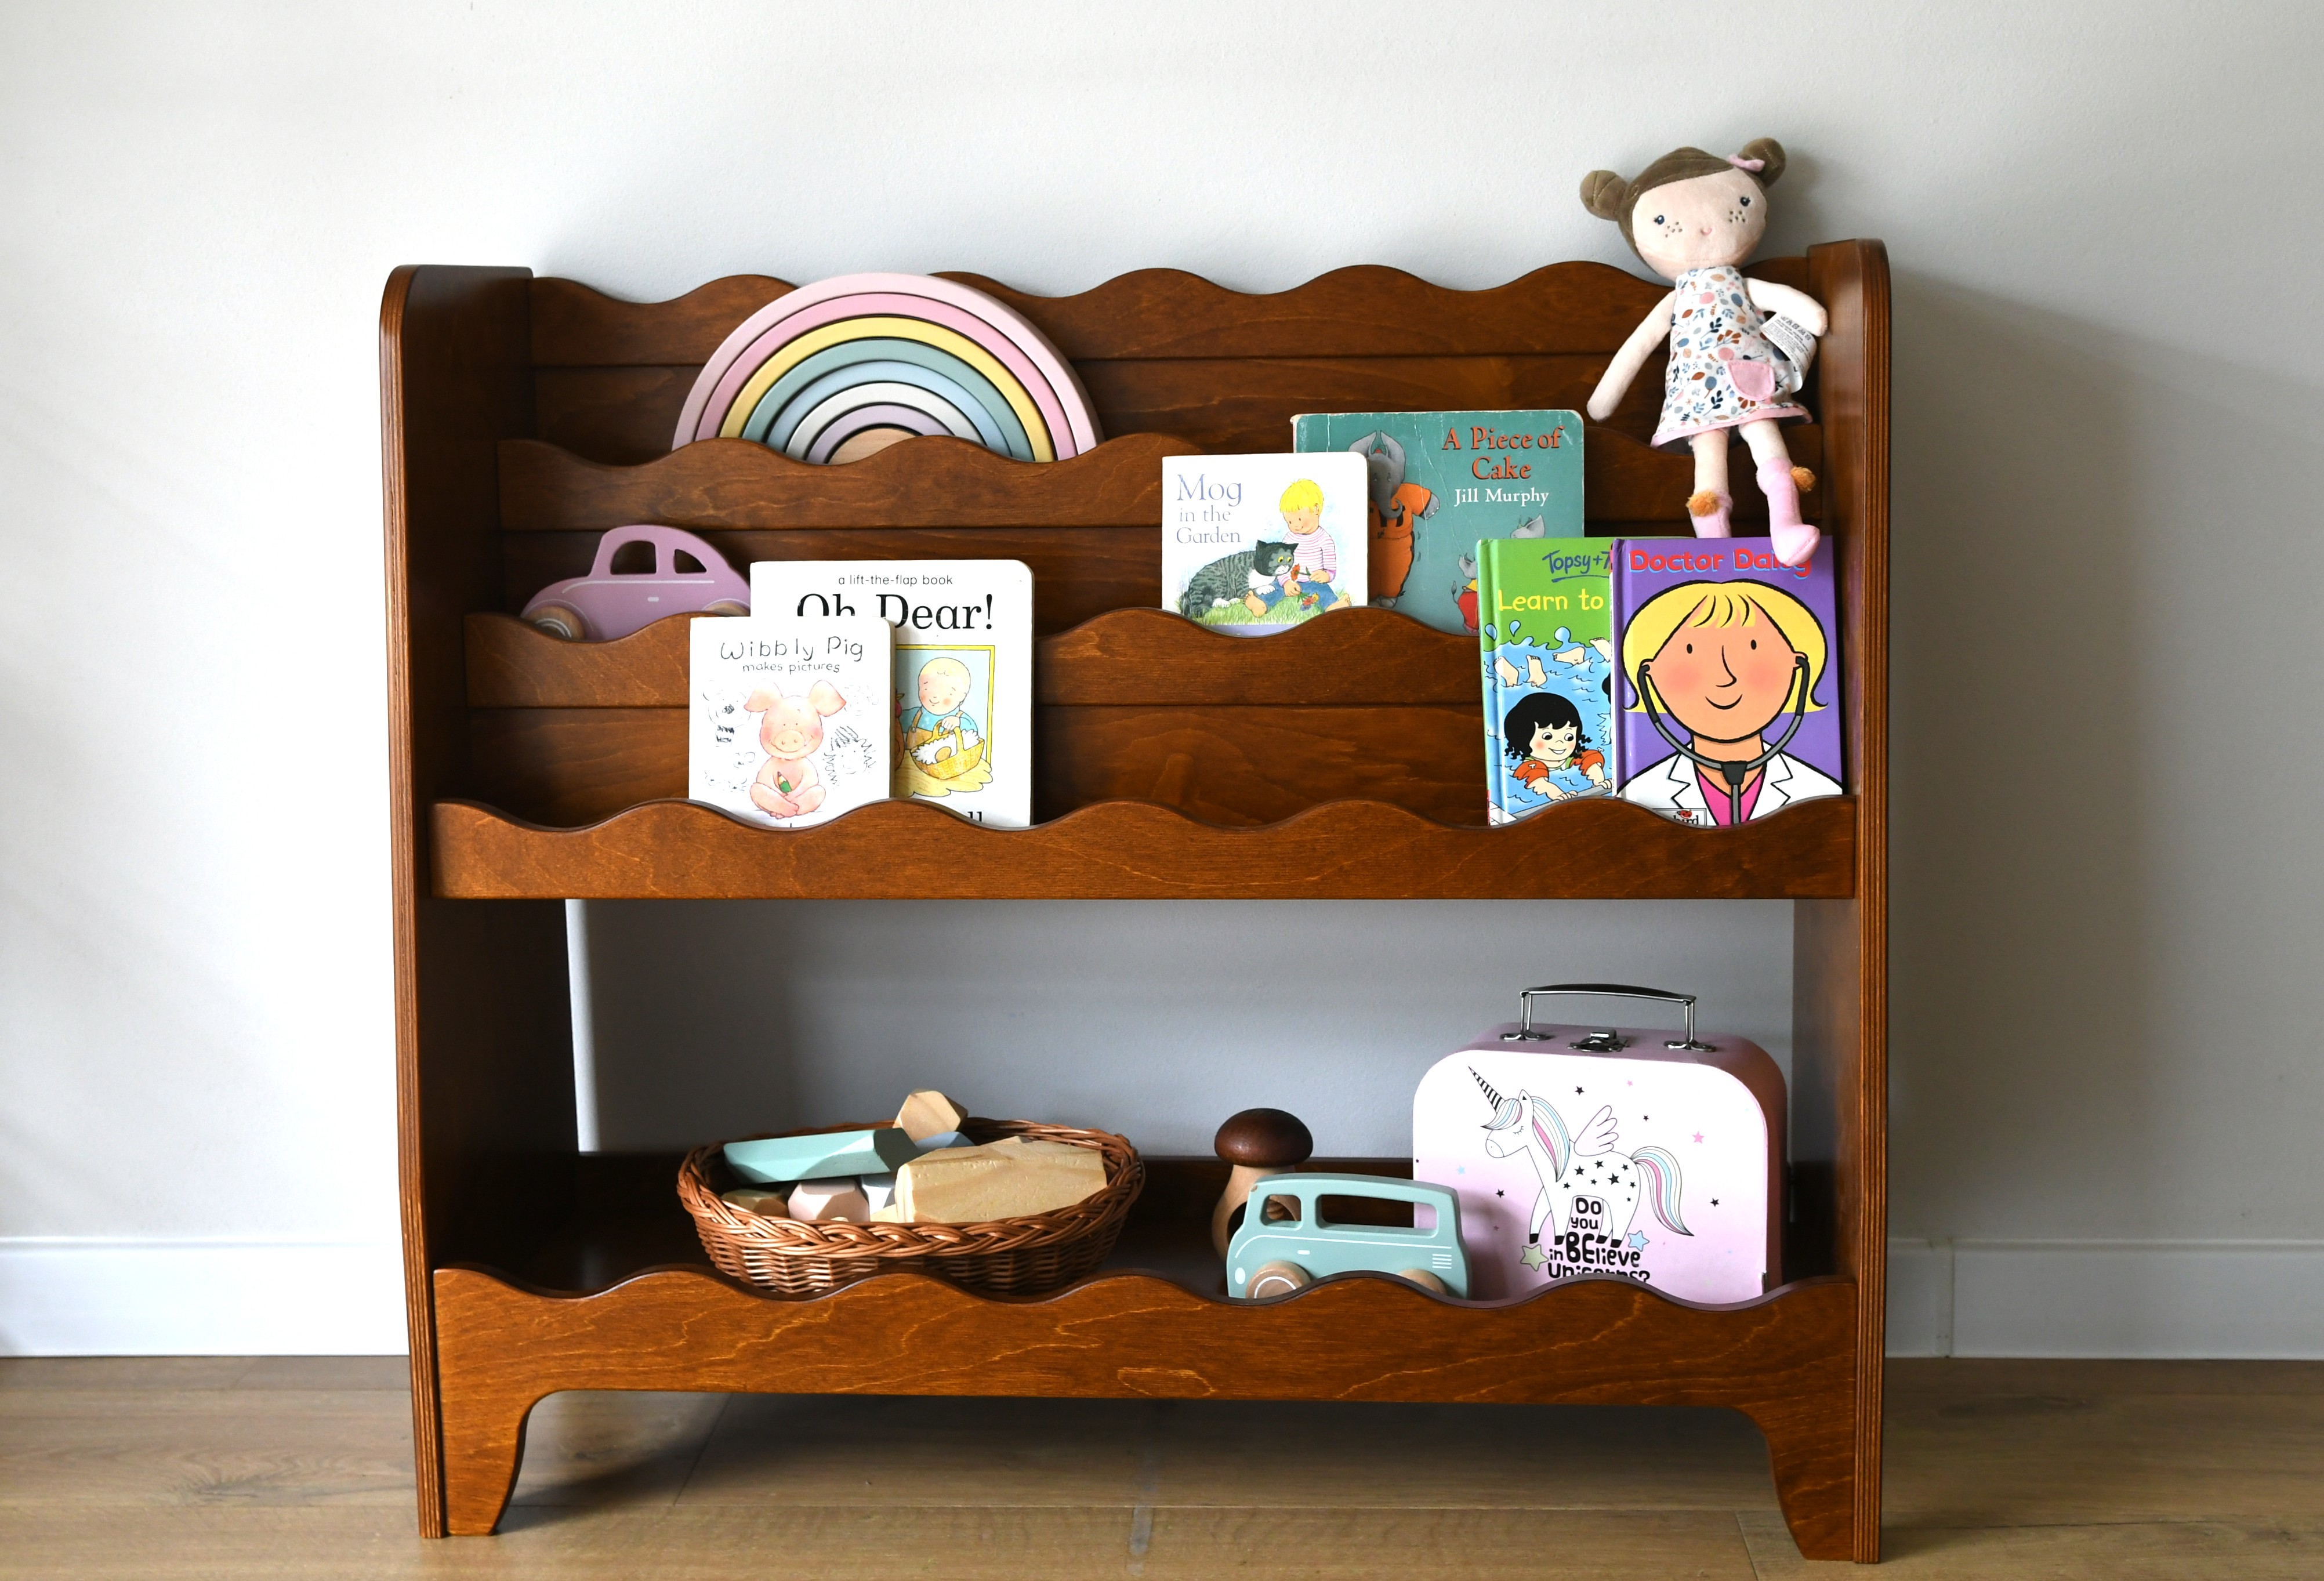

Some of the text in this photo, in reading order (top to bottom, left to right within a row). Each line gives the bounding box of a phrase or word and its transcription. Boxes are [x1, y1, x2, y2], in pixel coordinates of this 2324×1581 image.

[1442, 426, 1565, 449] A Piece of
[1472, 455, 1531, 480] Cake
[1177, 474, 1241, 507] Mog
[1454, 487, 1549, 507] Jill Murphy
[1180, 505, 1231, 522] in the
[1176, 526, 1241, 544] Garden
[1629, 549, 1724, 573] Doctor
[839, 575, 953, 587] a lift-the-flap book
[876, 593, 993, 629] Dear!
[1498, 589, 1604, 612] Learn to
[720, 636, 863, 662] Wibbly Pig
[742, 661, 840, 675] makes pictures
[1571, 1217, 1598, 1230] you
[1549, 1249, 1564, 1261] in
